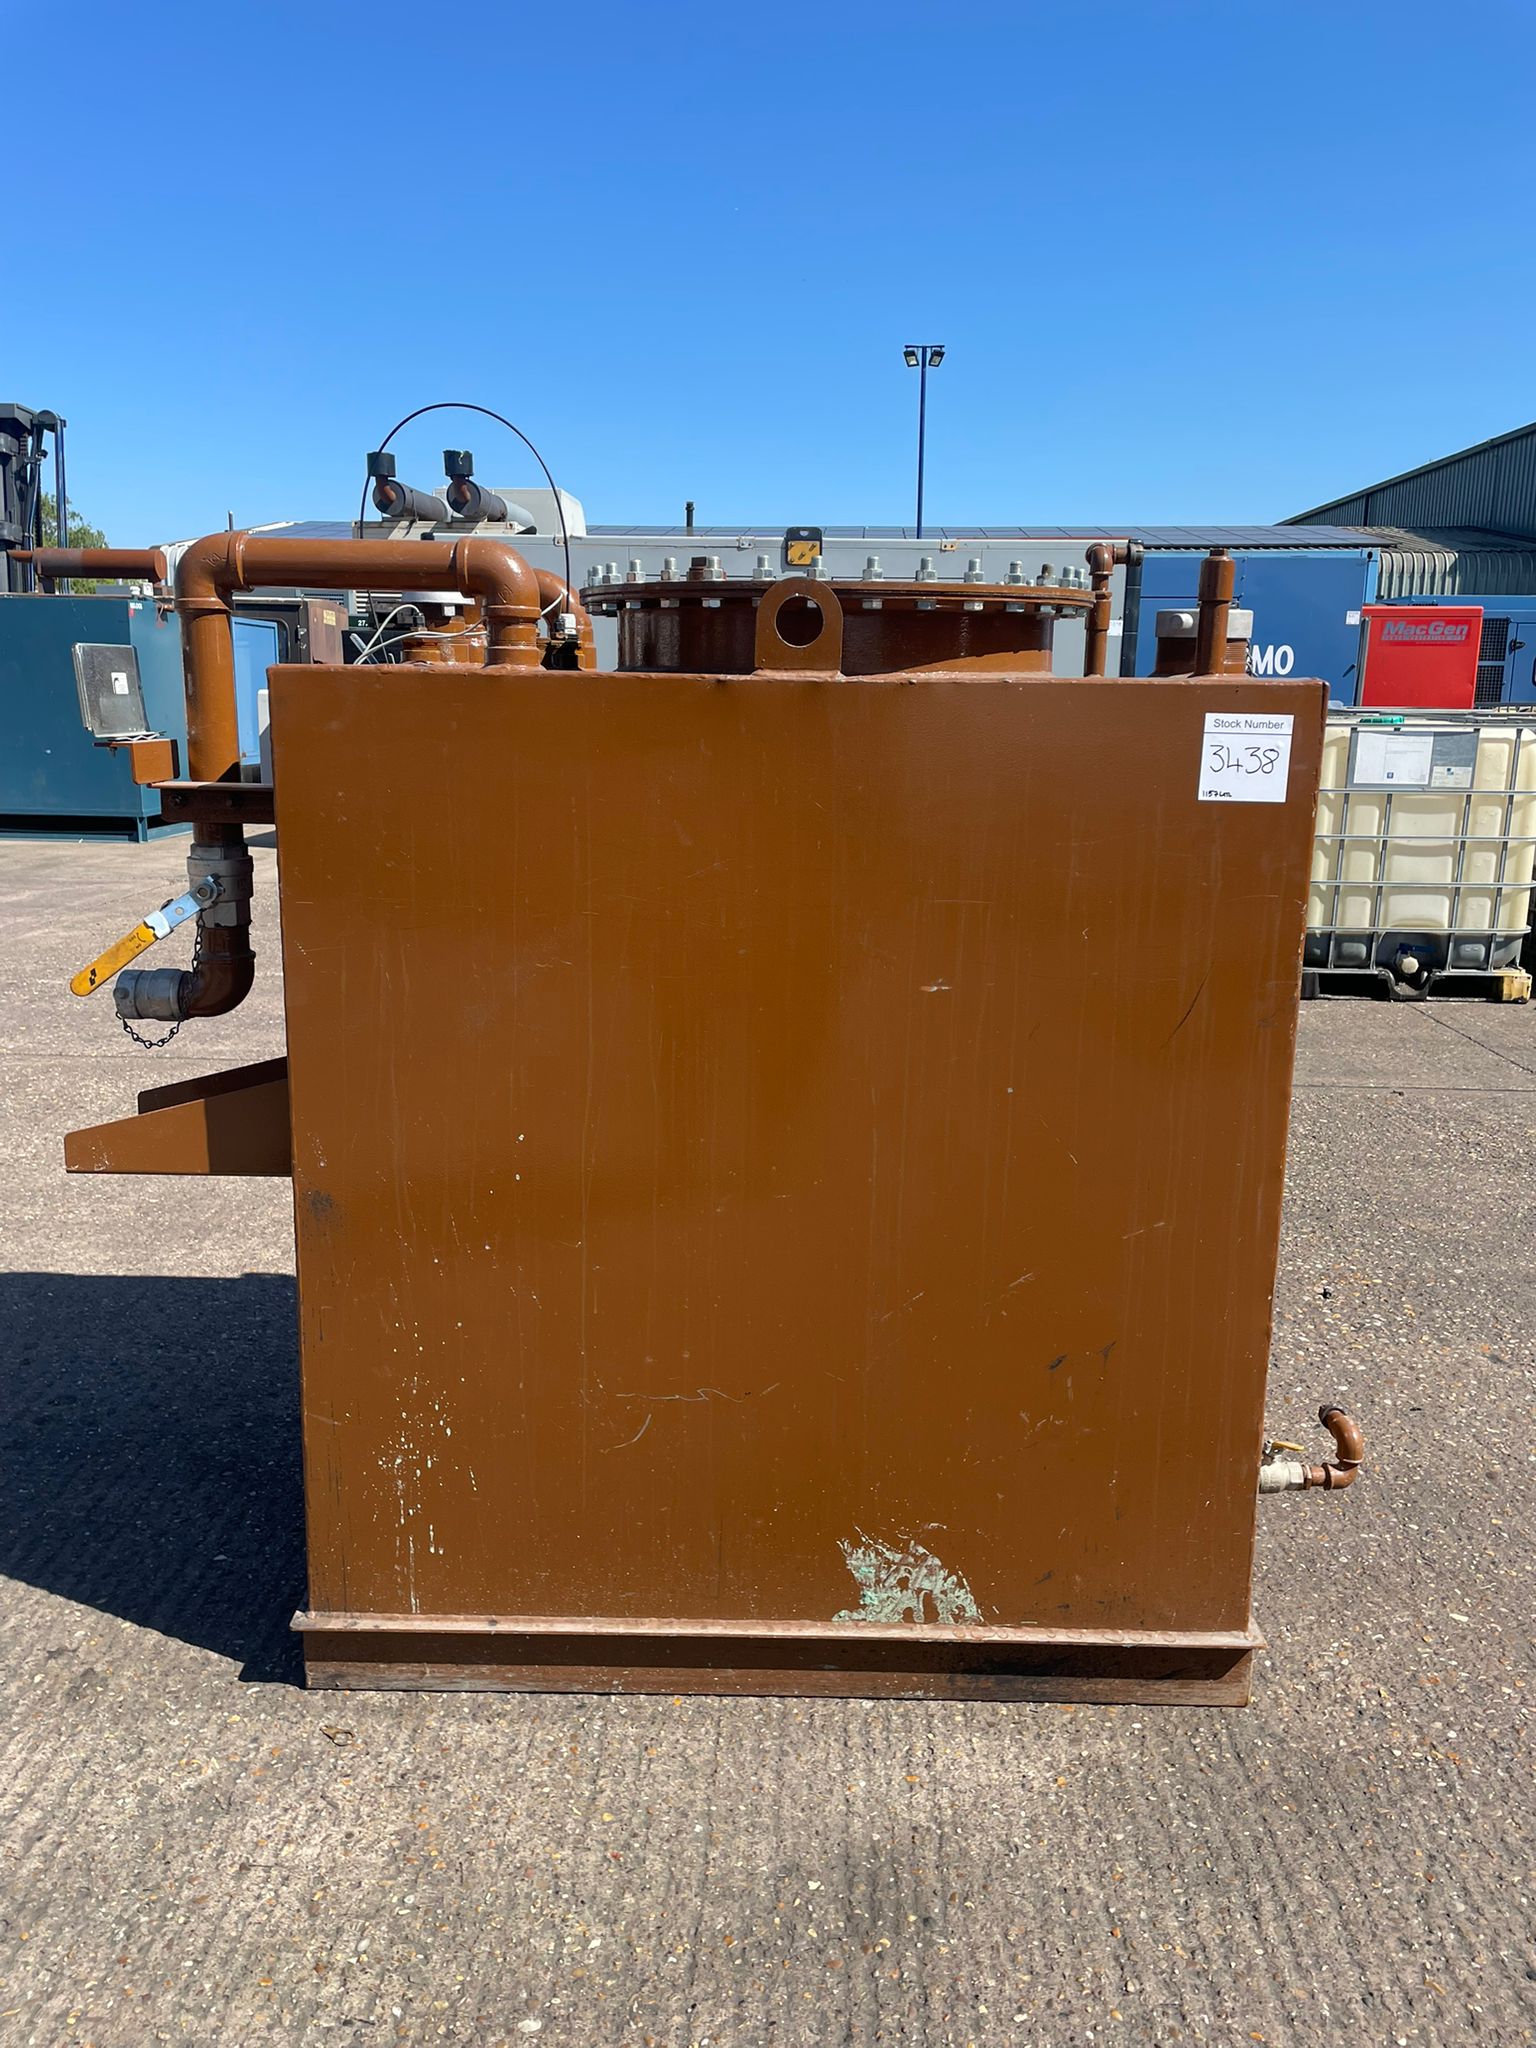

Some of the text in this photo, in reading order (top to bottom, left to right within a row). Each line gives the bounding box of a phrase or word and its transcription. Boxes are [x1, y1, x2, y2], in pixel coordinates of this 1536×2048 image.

[1383, 620, 1469, 635] MacGen
[1213, 718, 1285, 730] Stock Number
[1209, 744, 1280, 775] 3438
